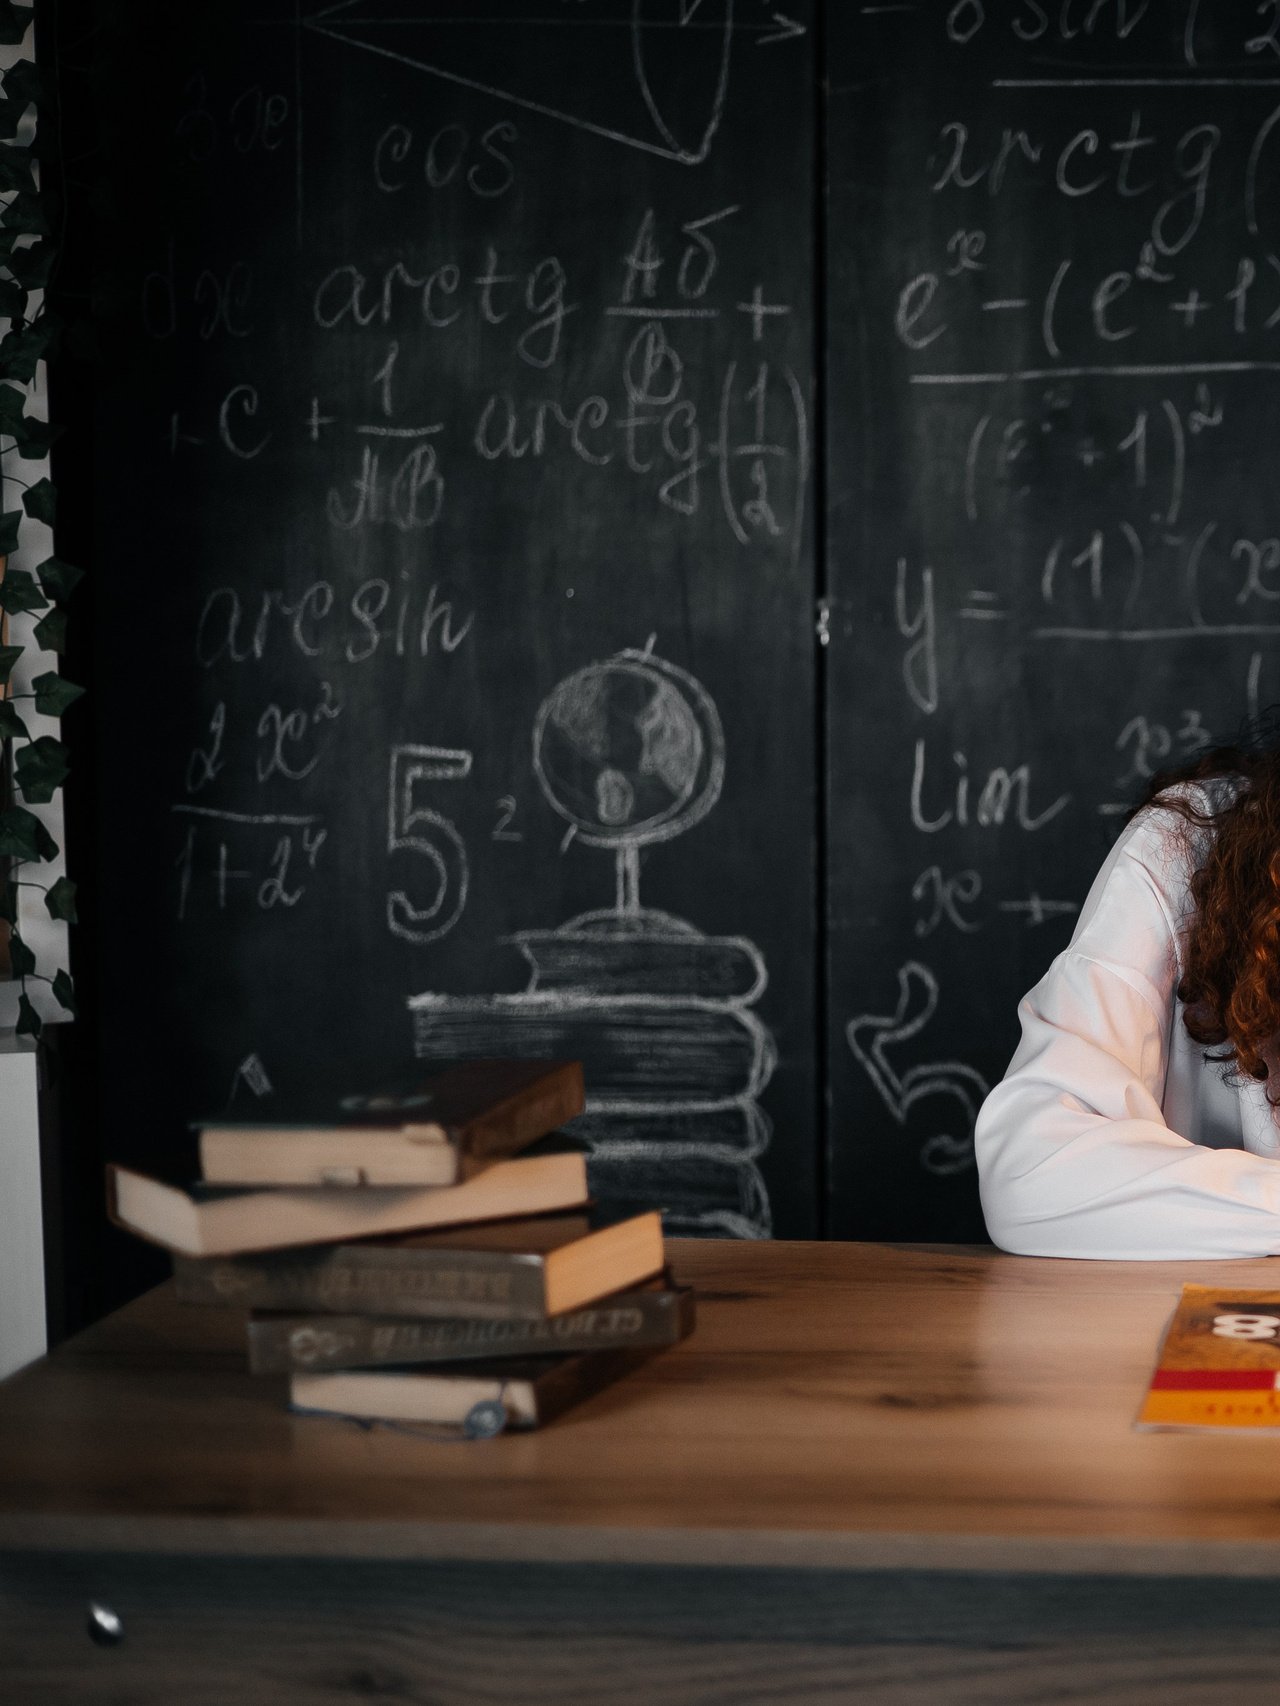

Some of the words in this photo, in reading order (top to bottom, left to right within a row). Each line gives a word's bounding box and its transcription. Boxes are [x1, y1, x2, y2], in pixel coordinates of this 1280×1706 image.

[375, 121, 518, 197] cos
[314, 247, 580, 368] arctg
[197, 575, 474, 668] arcsin
[387, 743, 474, 943] 5
[1213, 1314, 1280, 1340] 8
